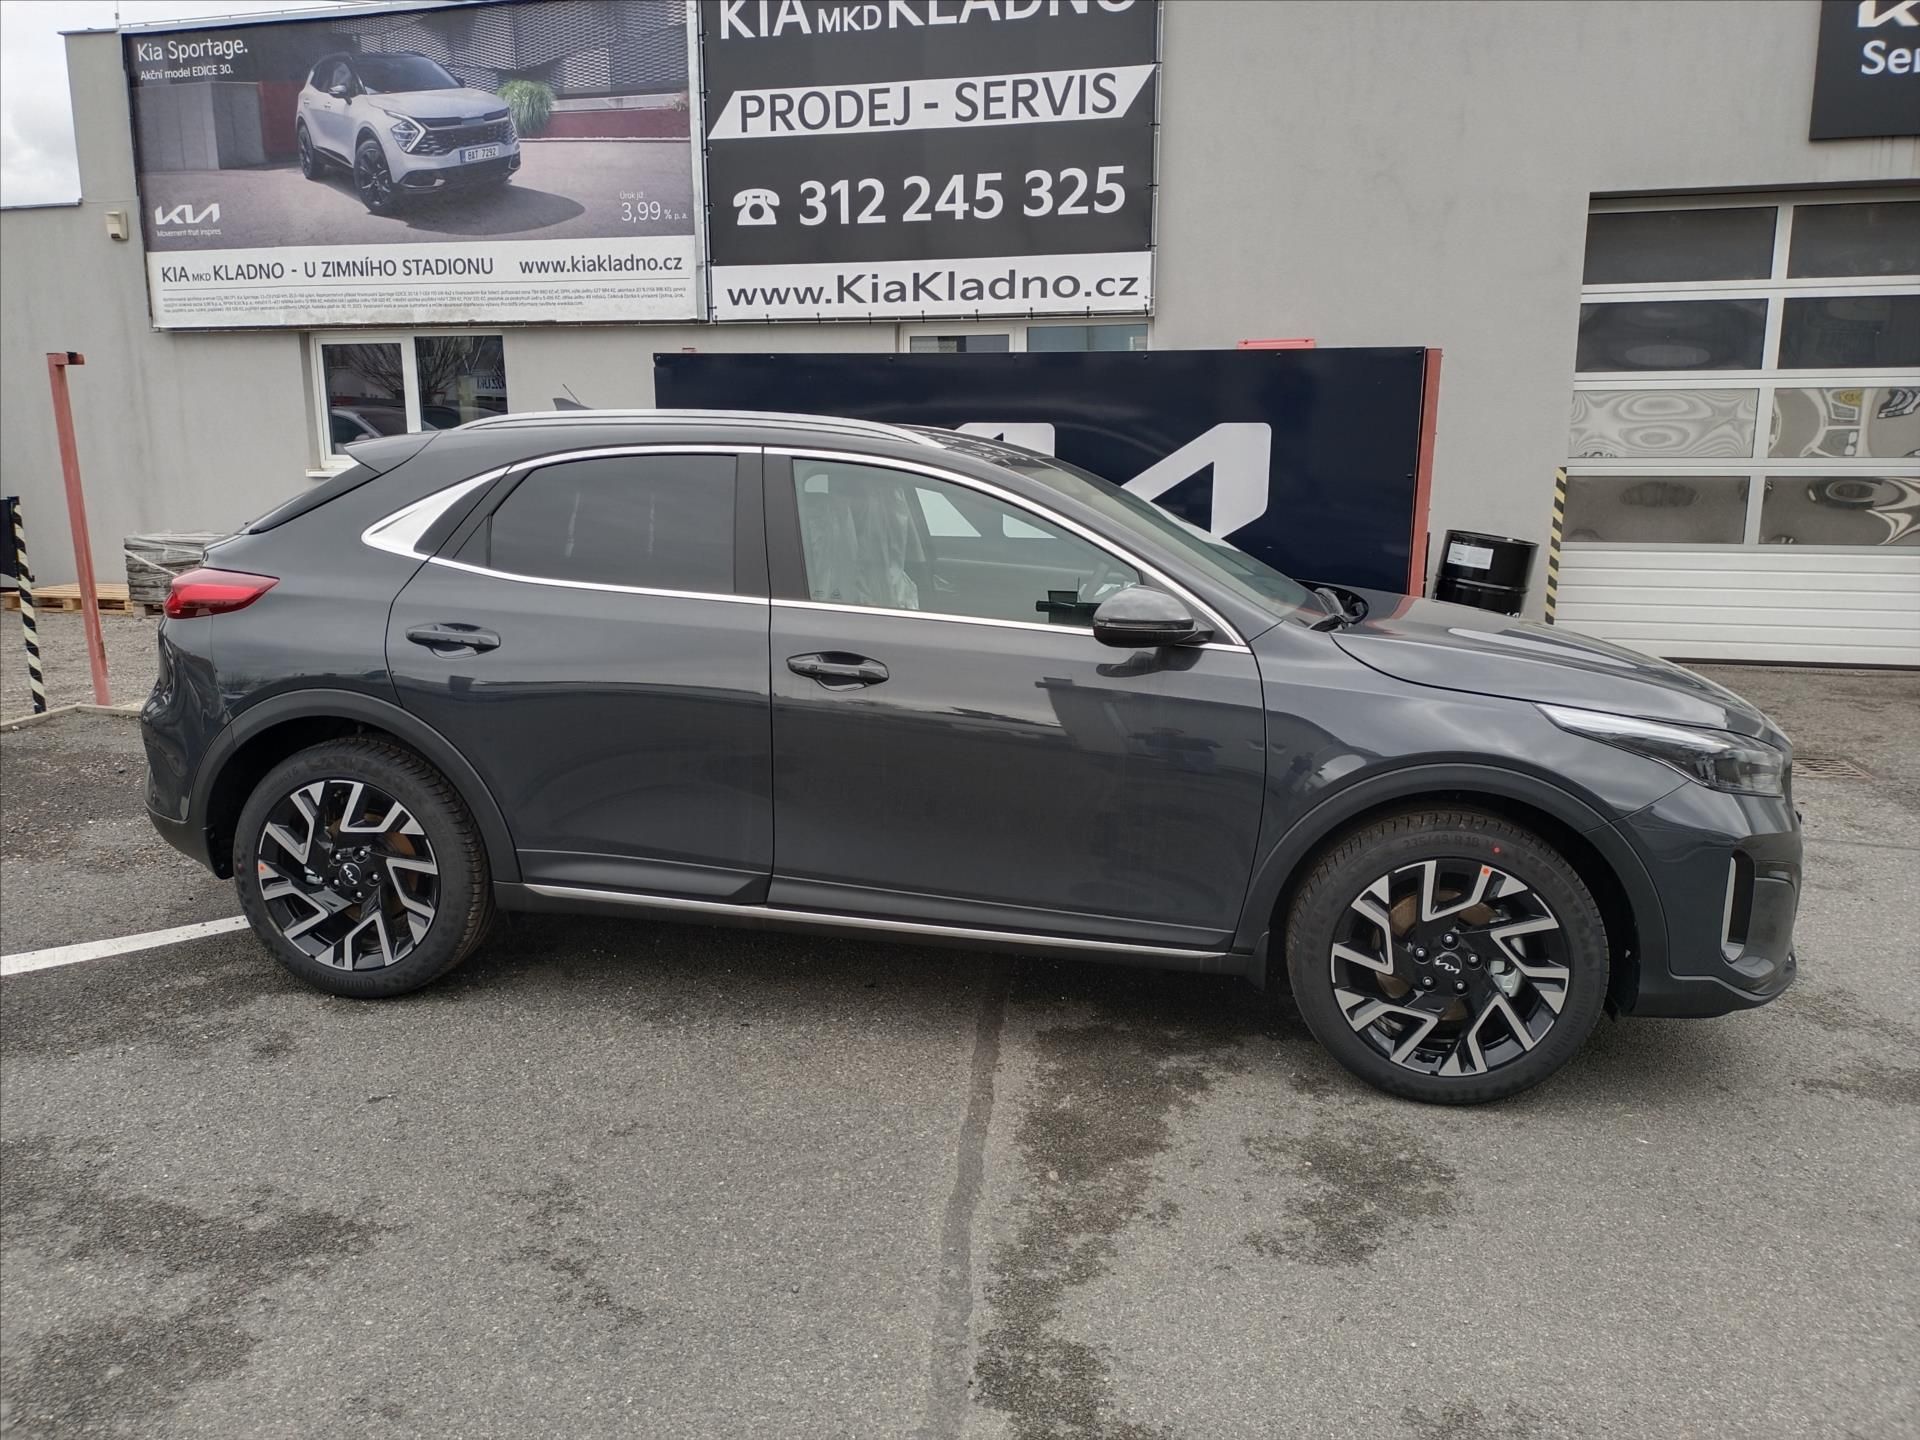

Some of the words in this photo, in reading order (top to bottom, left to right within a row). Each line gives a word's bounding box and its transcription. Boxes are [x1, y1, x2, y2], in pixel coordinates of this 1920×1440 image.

[720, 0, 811, 39] KIA
[818, 5, 882, 33] MKD
[137, 43, 163, 62] Kia
[167, 38, 248, 63] Sportage.
[140, 69, 163, 80] Akční
[164, 66, 191, 79] model
[192, 65, 218, 76] EDICE
[219, 64, 234, 74] 30.
[740, 86, 910, 133] PRODEJ
[955, 72, 1117, 122] SERVIS
[799, 178, 886, 226] 312
[902, 172, 1003, 222] 245
[1023, 166, 1126, 217] 325
[155, 203, 221, 225] KIA
[621, 201, 661, 223] 3,99
[161, 266, 190, 282] KIA
[192, 272, 211, 282] MKD
[213, 262, 285, 281] KLADNO
[304, 261, 316, 278] U
[321, 256, 397, 278] ZIMNÍHO
[402, 257, 493, 276] STADIONU
[519, 253, 683, 274] www.kiakladno.cz
[727, 269, 1139, 306] www.KiaKladno.cz
